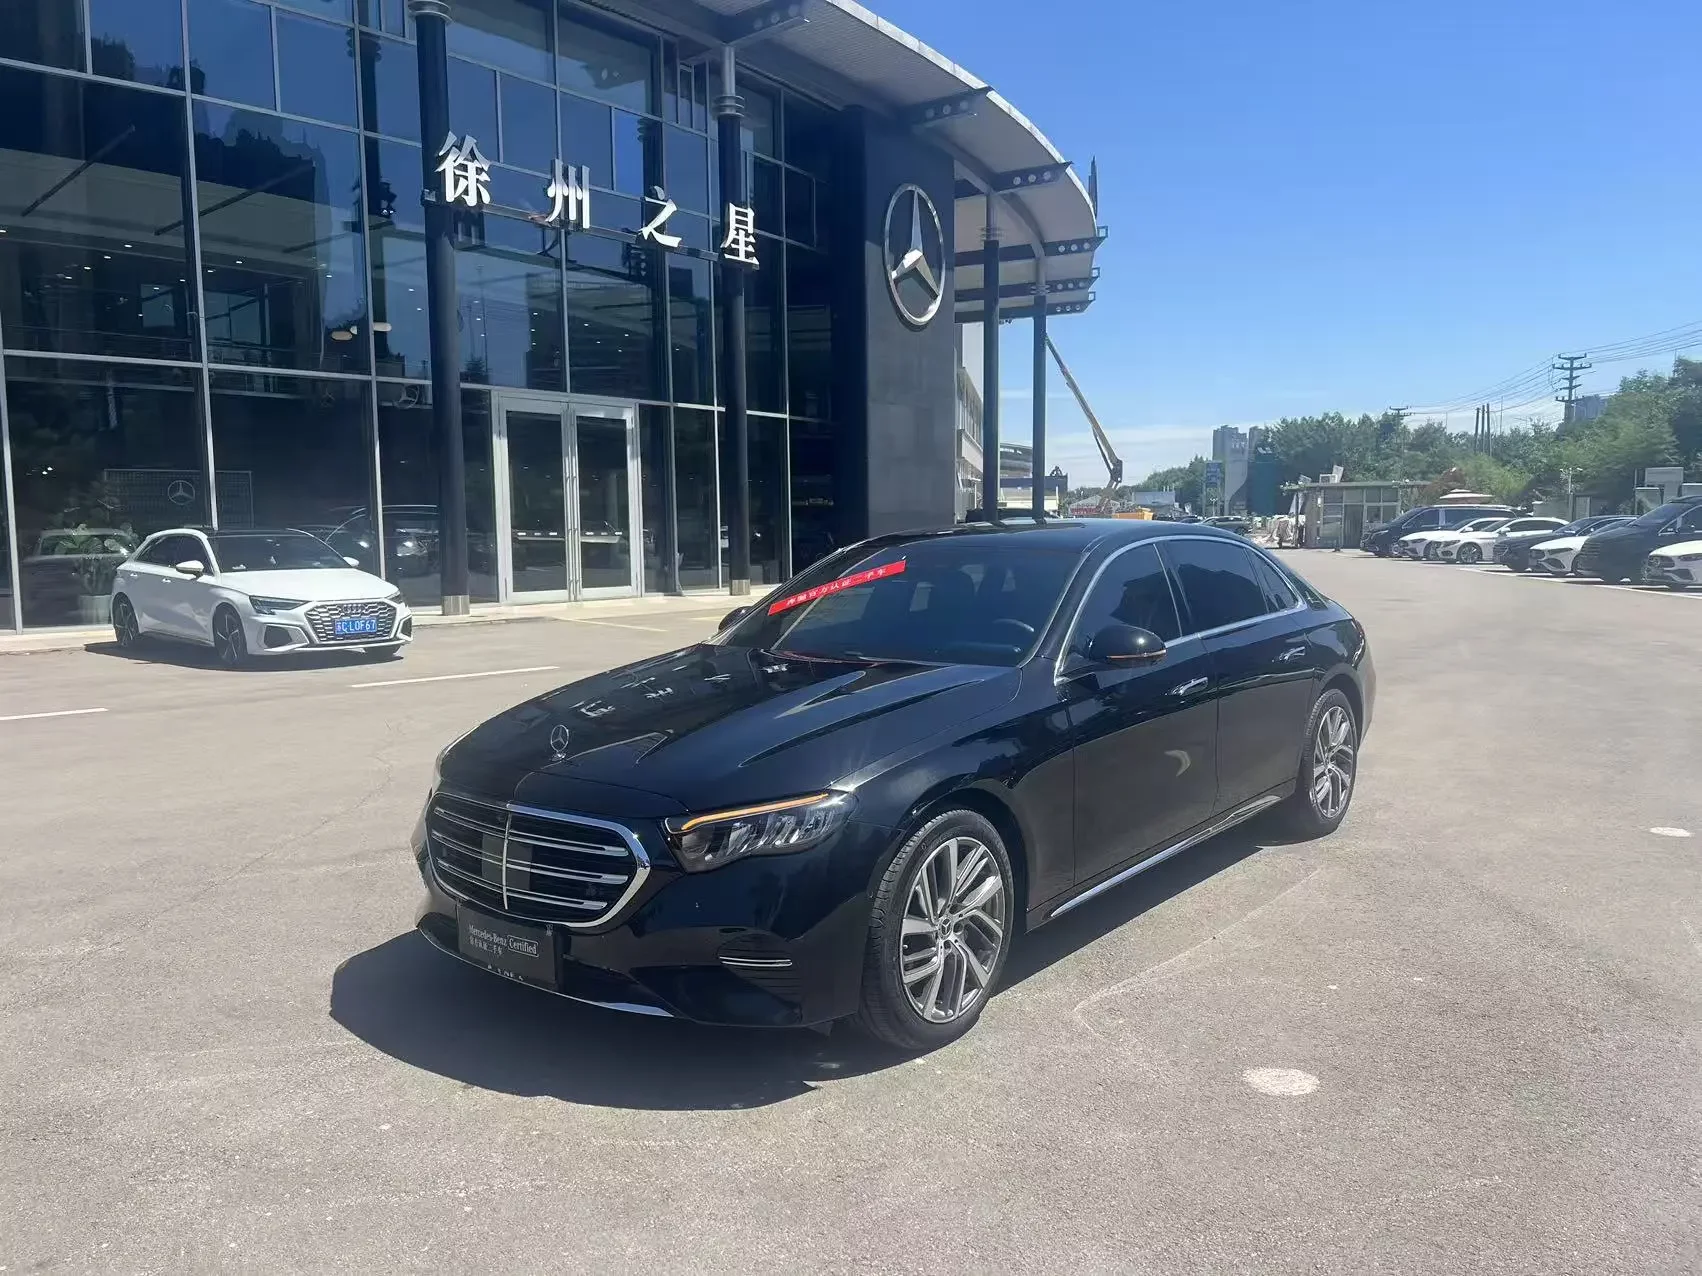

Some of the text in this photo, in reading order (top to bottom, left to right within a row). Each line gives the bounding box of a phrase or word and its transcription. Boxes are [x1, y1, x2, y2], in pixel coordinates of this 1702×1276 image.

[435, 131, 759, 269] 徐州之星
[469, 924, 537, 954] Mercedes-Benz Certified
